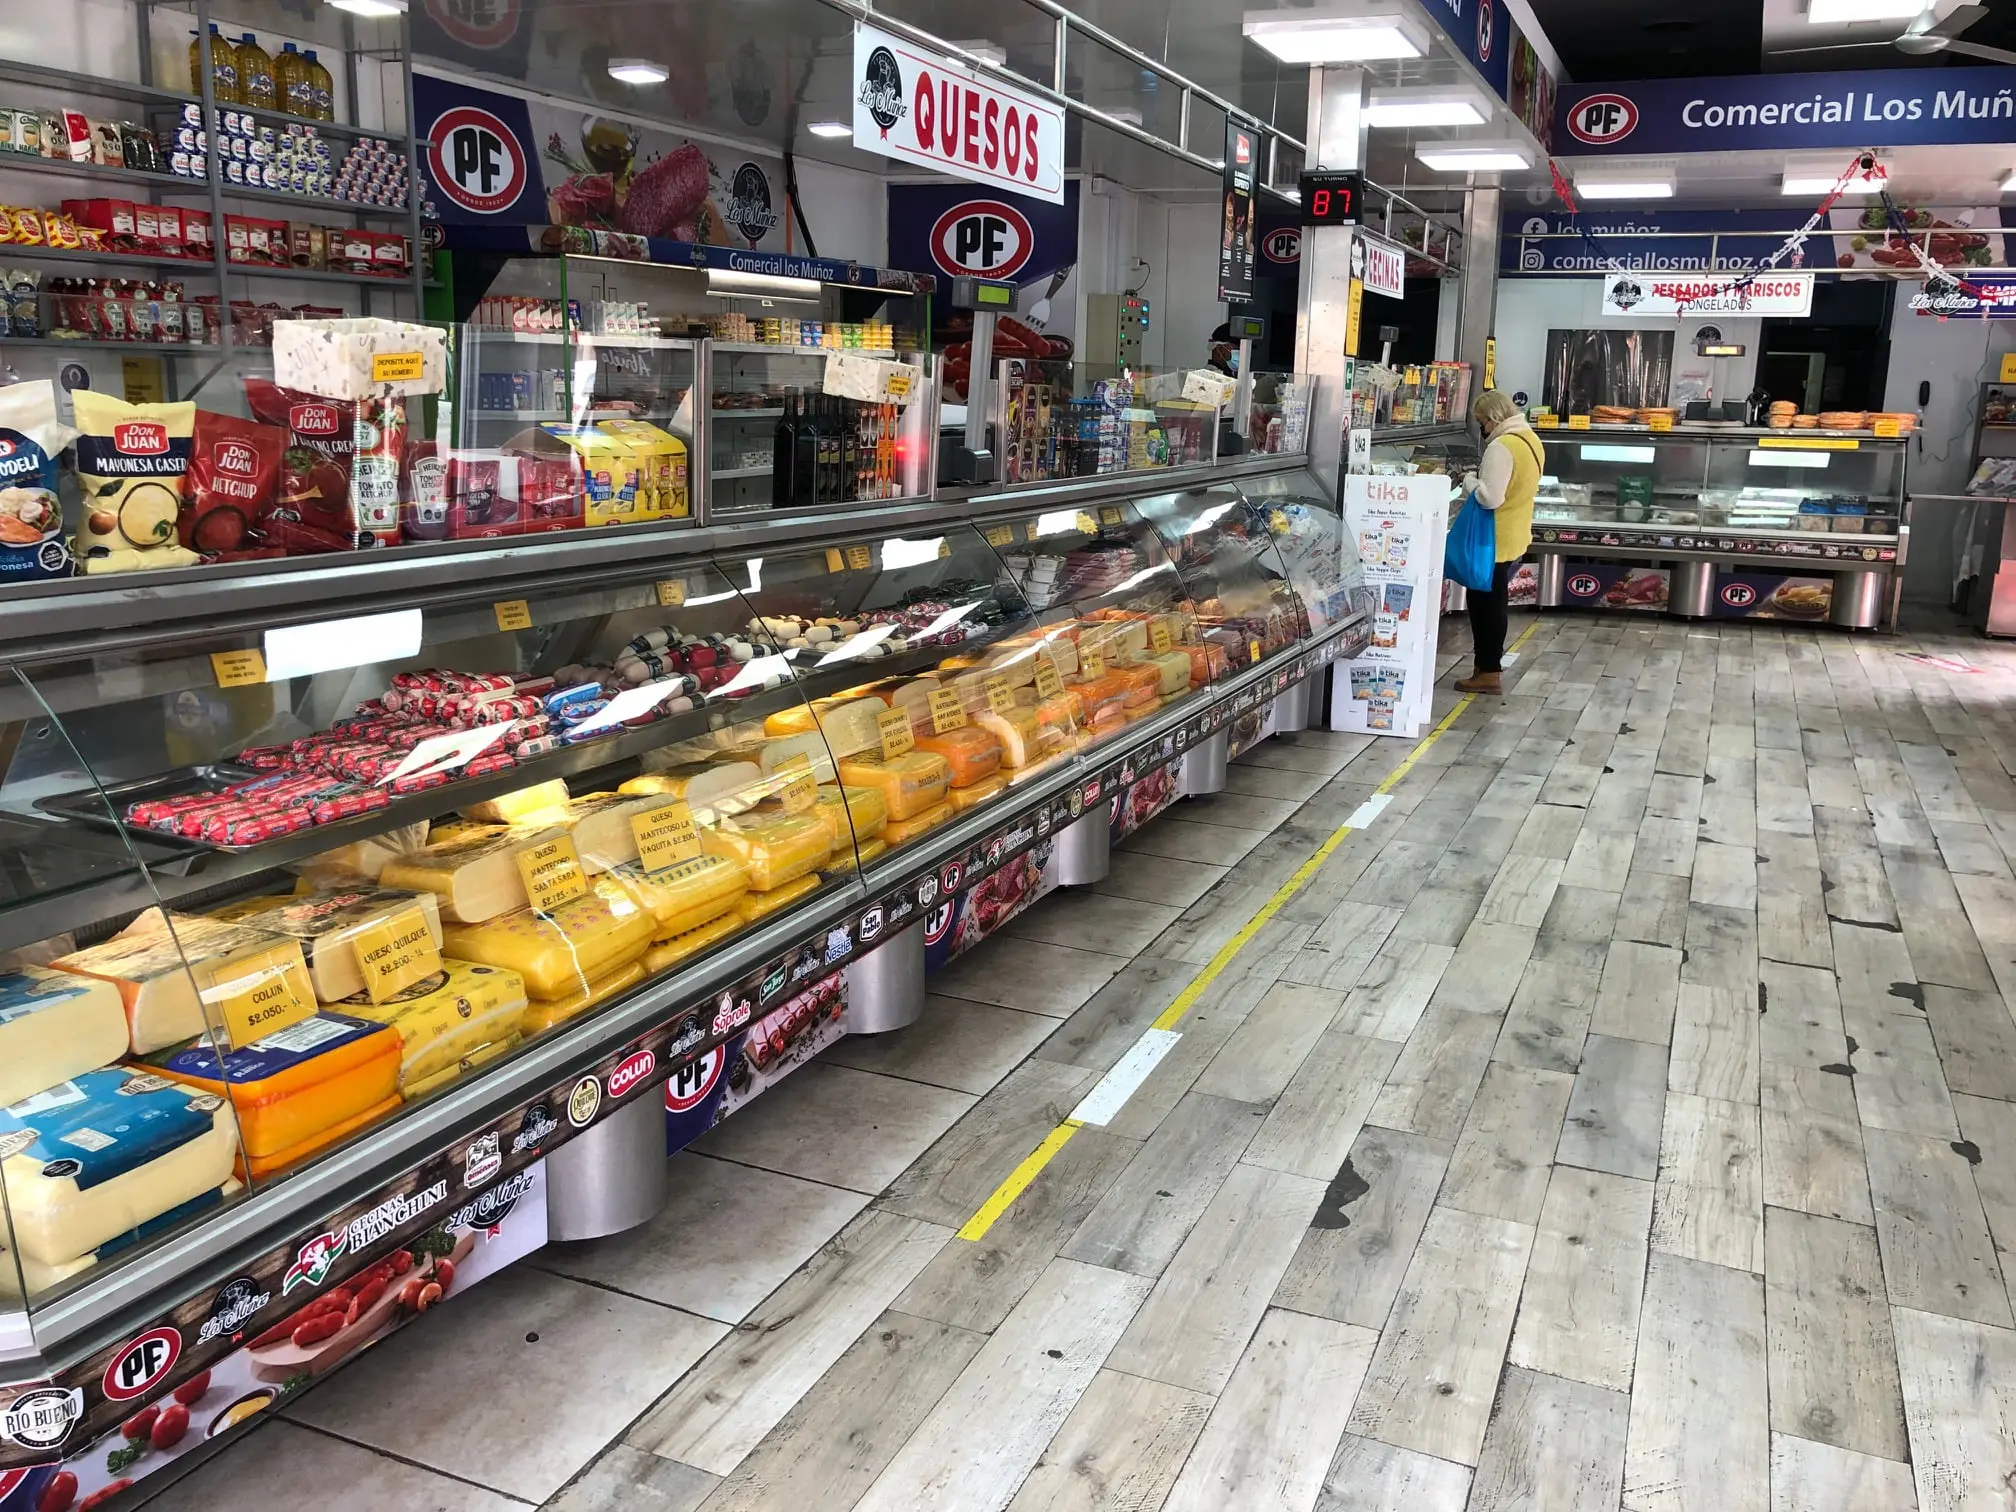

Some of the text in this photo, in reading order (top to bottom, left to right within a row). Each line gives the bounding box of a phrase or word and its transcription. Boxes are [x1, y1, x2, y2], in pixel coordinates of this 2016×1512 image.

[1585, 104, 1621, 135] PF
[1682, 93, 1853, 129] Comercial
[1864, 91, 1922, 121] Los
[914, 71, 1039, 182] QUESOS
[453, 128, 502, 196] PF
[1312, 190, 1351, 216] 87
[424, 227, 441, 242] PF
[956, 217, 1006, 267] PF
[1274, 235, 1296, 256] PF
[729, 252, 834, 281] Comercial los Muñoz
[1369, 248, 1400, 290] CECINAS
[1553, 252, 1776, 271] comerciallosmunoz.c
[1734, 281, 1801, 298] MARISCOS
[377, 359, 404, 367] DEPOSITE
[297, 417, 331, 430] JUAN
[304, 408, 326, 418] DON
[130, 425, 155, 436] DON
[121, 435, 162, 449] JUAN
[229, 447, 251, 458] DON
[97, 458, 153, 473] MAYONESA
[219, 458, 252, 472] JUAN
[211, 477, 258, 499] KETCHUP
[1368, 481, 1408, 501] tika
[1392, 536, 1404, 544] tika
[1575, 579, 1593, 592] PF
[1730, 588, 1748, 601] PF
[1357, 669, 1370, 677] tika
[1385, 670, 1399, 679] tika
[651, 811, 673, 823] QUESO
[640, 820, 690, 841] MANTECOSO LA
[534, 844, 558, 860] QUESO
[640, 839, 672, 855] VAQUITA
[530, 855, 571, 877] MANTECOSO
[533, 869, 578, 894] SANTA SARA
[946, 867, 958, 888] PF
[864, 907, 877, 923] San
[926, 909, 944, 934] PF
[862, 919, 881, 936] Pablo
[364, 925, 428, 965] QUESO QUILQUE
[825, 940, 853, 965] Nestlé
[252, 983, 284, 1004] COLUN
[762, 982, 772, 996] San
[248, 1003, 288, 1027] $2.050.-
[713, 999, 750, 1035] Soprole
[610, 1054, 652, 1090] COLUN
[678, 1057, 708, 1097] PF
[350, 1194, 405, 1234] CECINAS
[445, 1173, 536, 1234] Los Muñoz
[351, 1180, 448, 1254] BIANCHINI
[122, 1340, 164, 1387] PF
[6, 1412, 31, 1434] RÍO
[35, 1398, 77, 1427] BUENO
